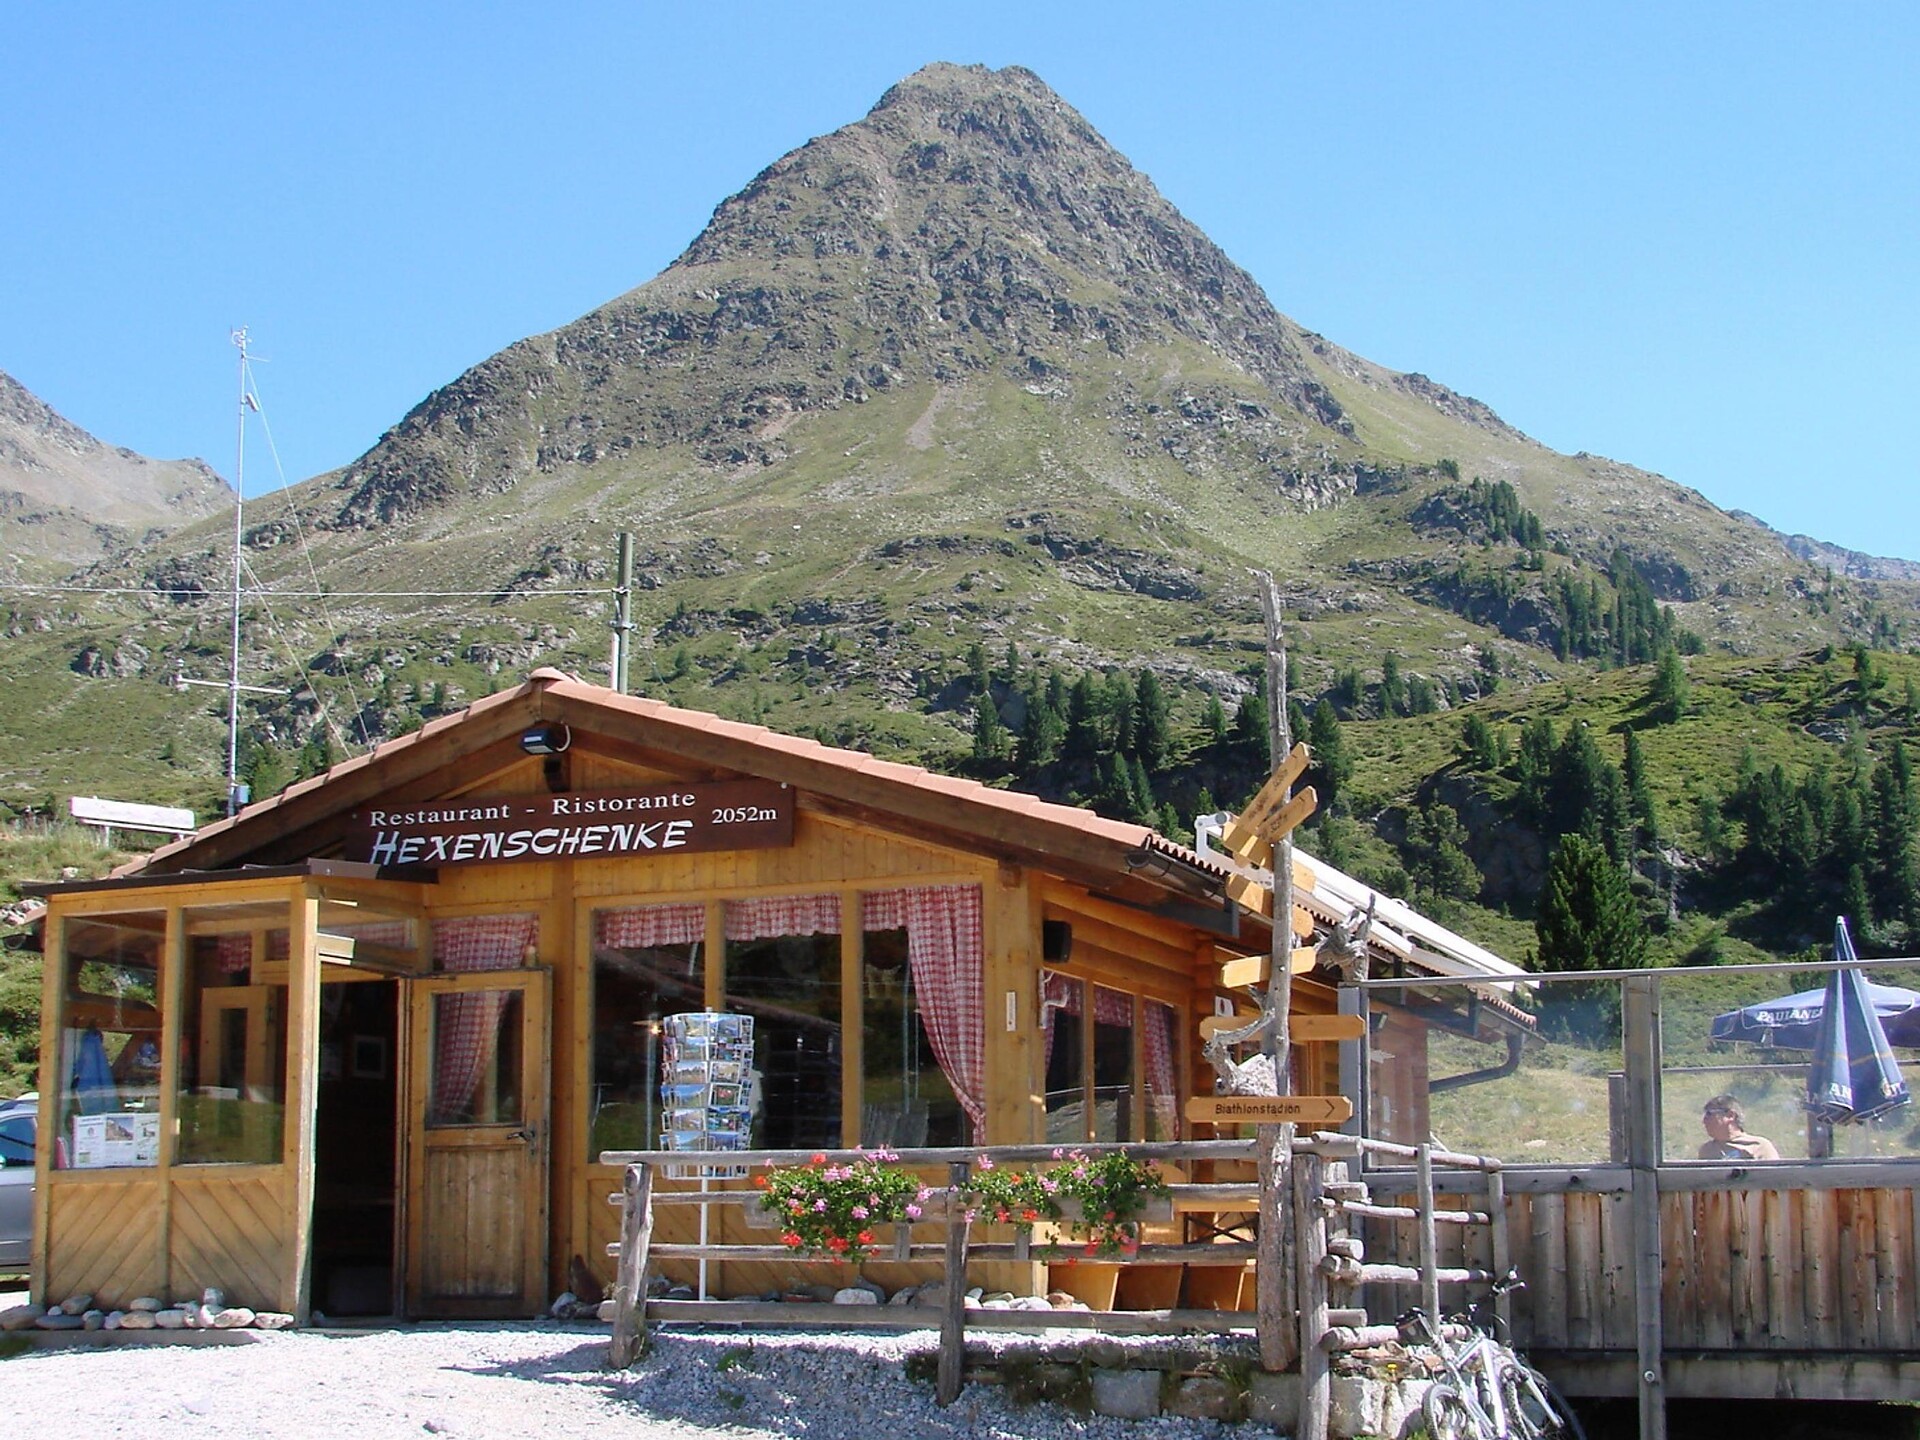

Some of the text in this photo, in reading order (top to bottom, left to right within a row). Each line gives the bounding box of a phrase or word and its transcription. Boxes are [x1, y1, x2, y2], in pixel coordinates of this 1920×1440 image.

[370, 804, 510, 827] Restaurant
[552, 792, 696, 816] Ristorante
[712, 806, 777, 824] 2052m
[369, 820, 693, 866] HEXENSCHENKE
[1215, 1103, 1301, 1116] Biathlonstadion
